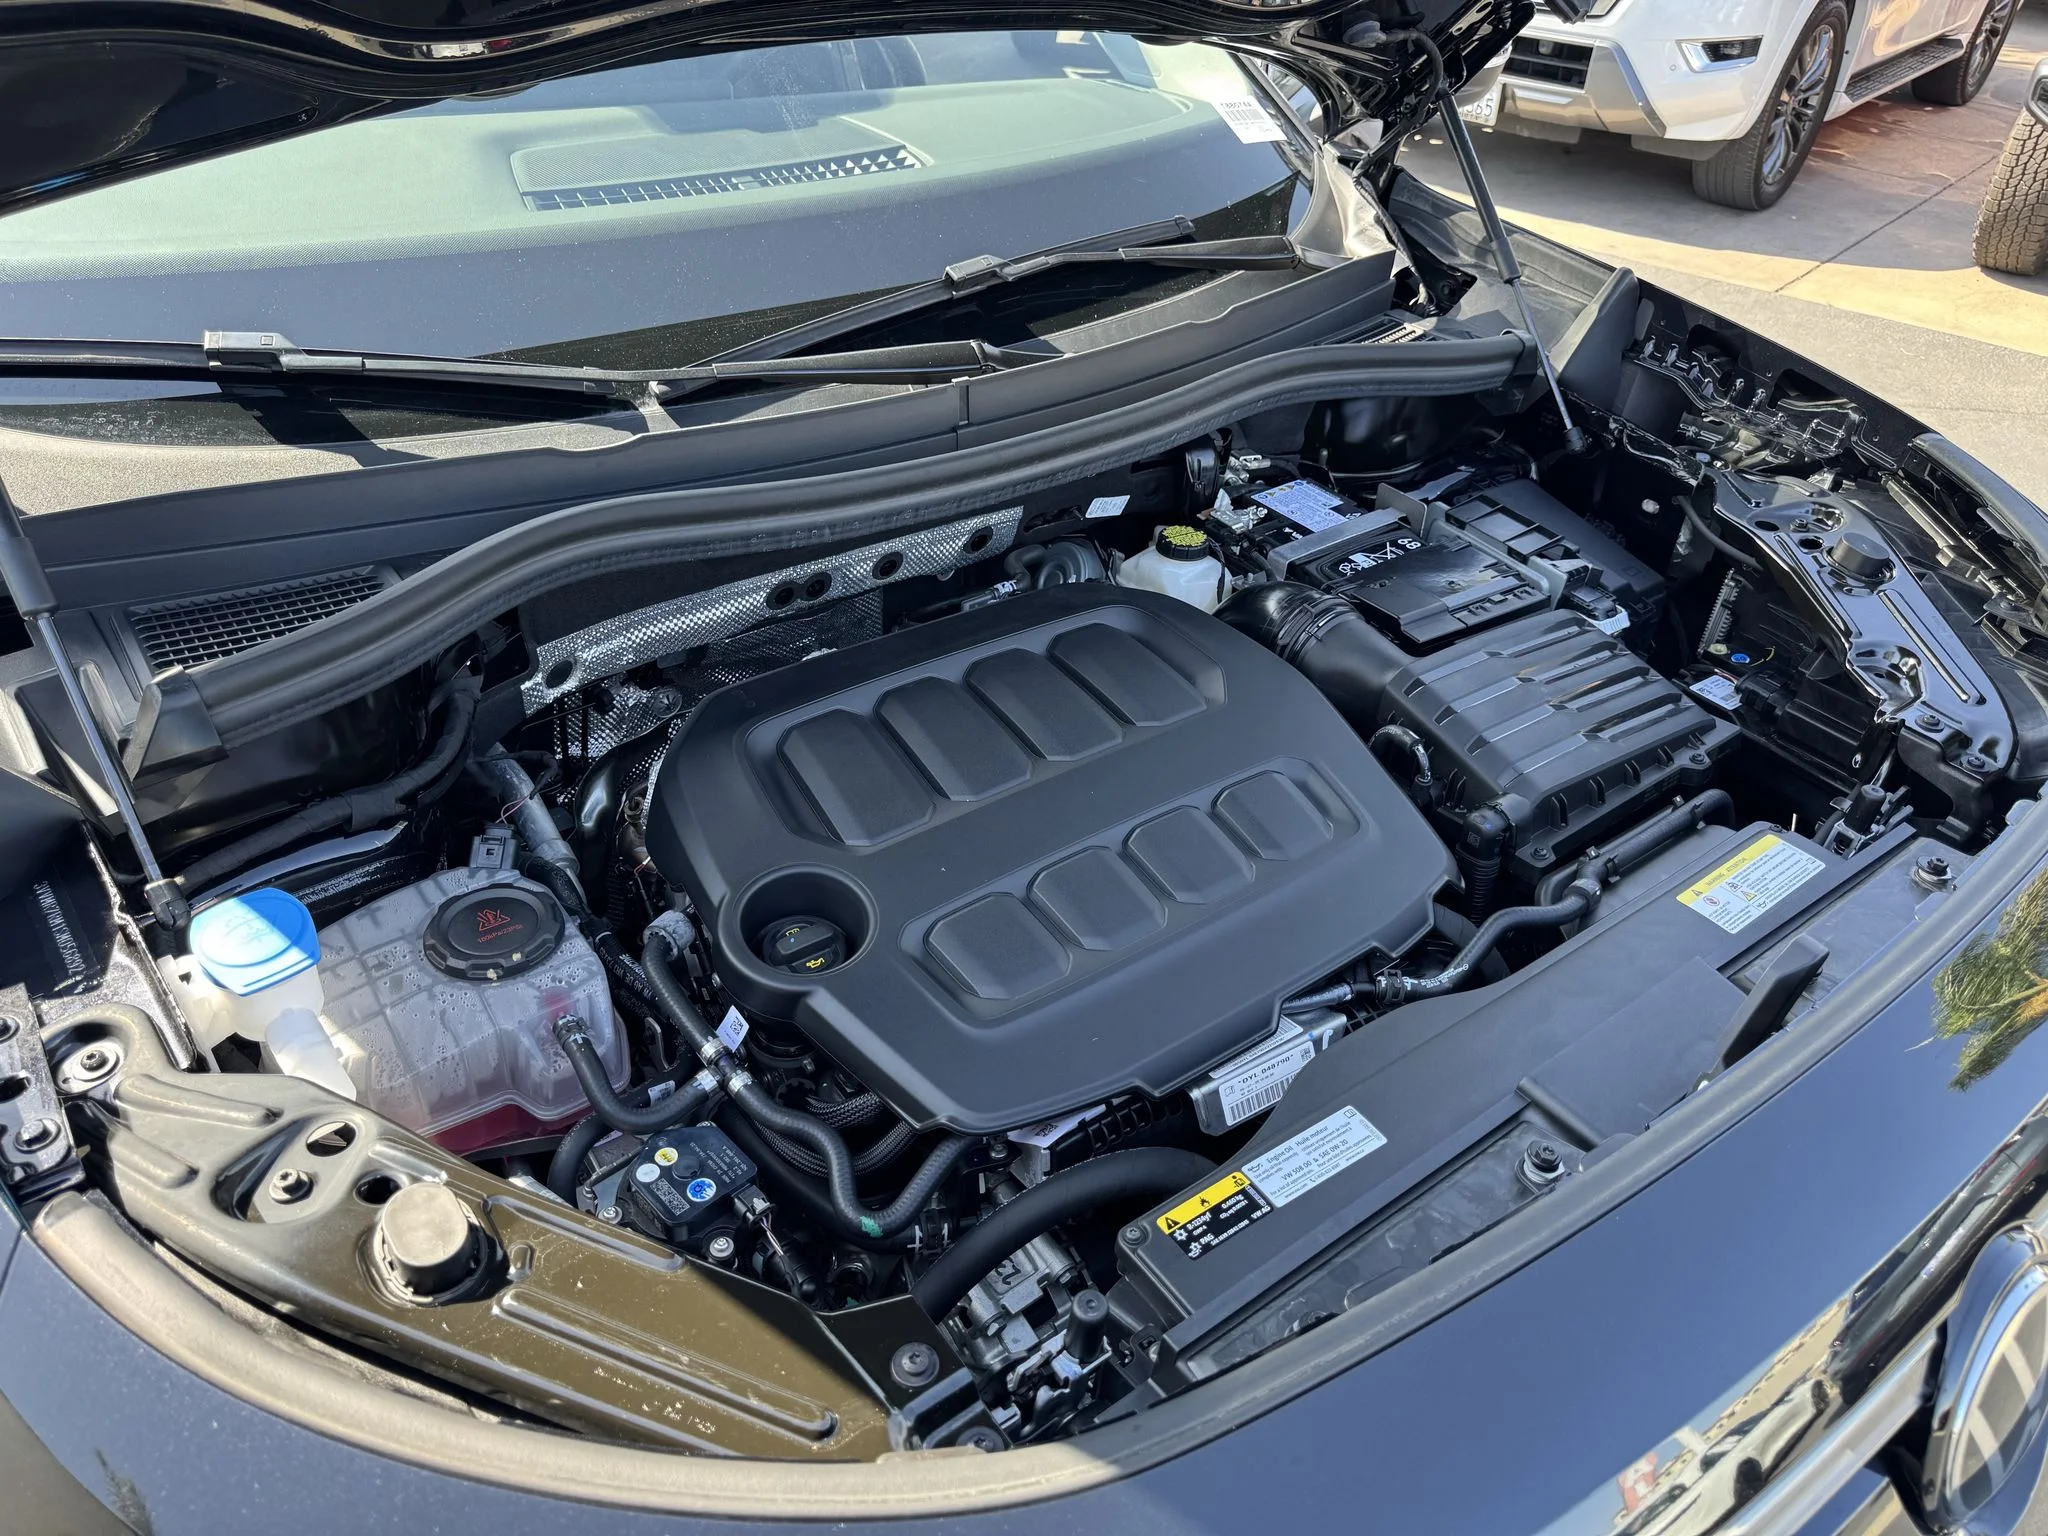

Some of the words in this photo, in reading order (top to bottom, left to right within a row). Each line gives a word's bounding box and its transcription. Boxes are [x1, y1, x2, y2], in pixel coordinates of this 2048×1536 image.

[1295, 1137, 1310, 1146] Huile
[1309, 1126, 1328, 1138] moteur
[1266, 1151, 1285, 1163] Engine
[1284, 1145, 1294, 1153] Oil
[1281, 1172, 1293, 1180] VW
[1292, 1166, 1304, 1174] 508
[1319, 1150, 1330, 1158] SAE
[1329, 1139, 1348, 1152] 0W-20
[1251, 1210, 1262, 1218] VW
[1262, 1205, 1270, 1213] AG
[1186, 1212, 1211, 1230] R-1234yf
[1200, 1233, 1214, 1244] PAG
